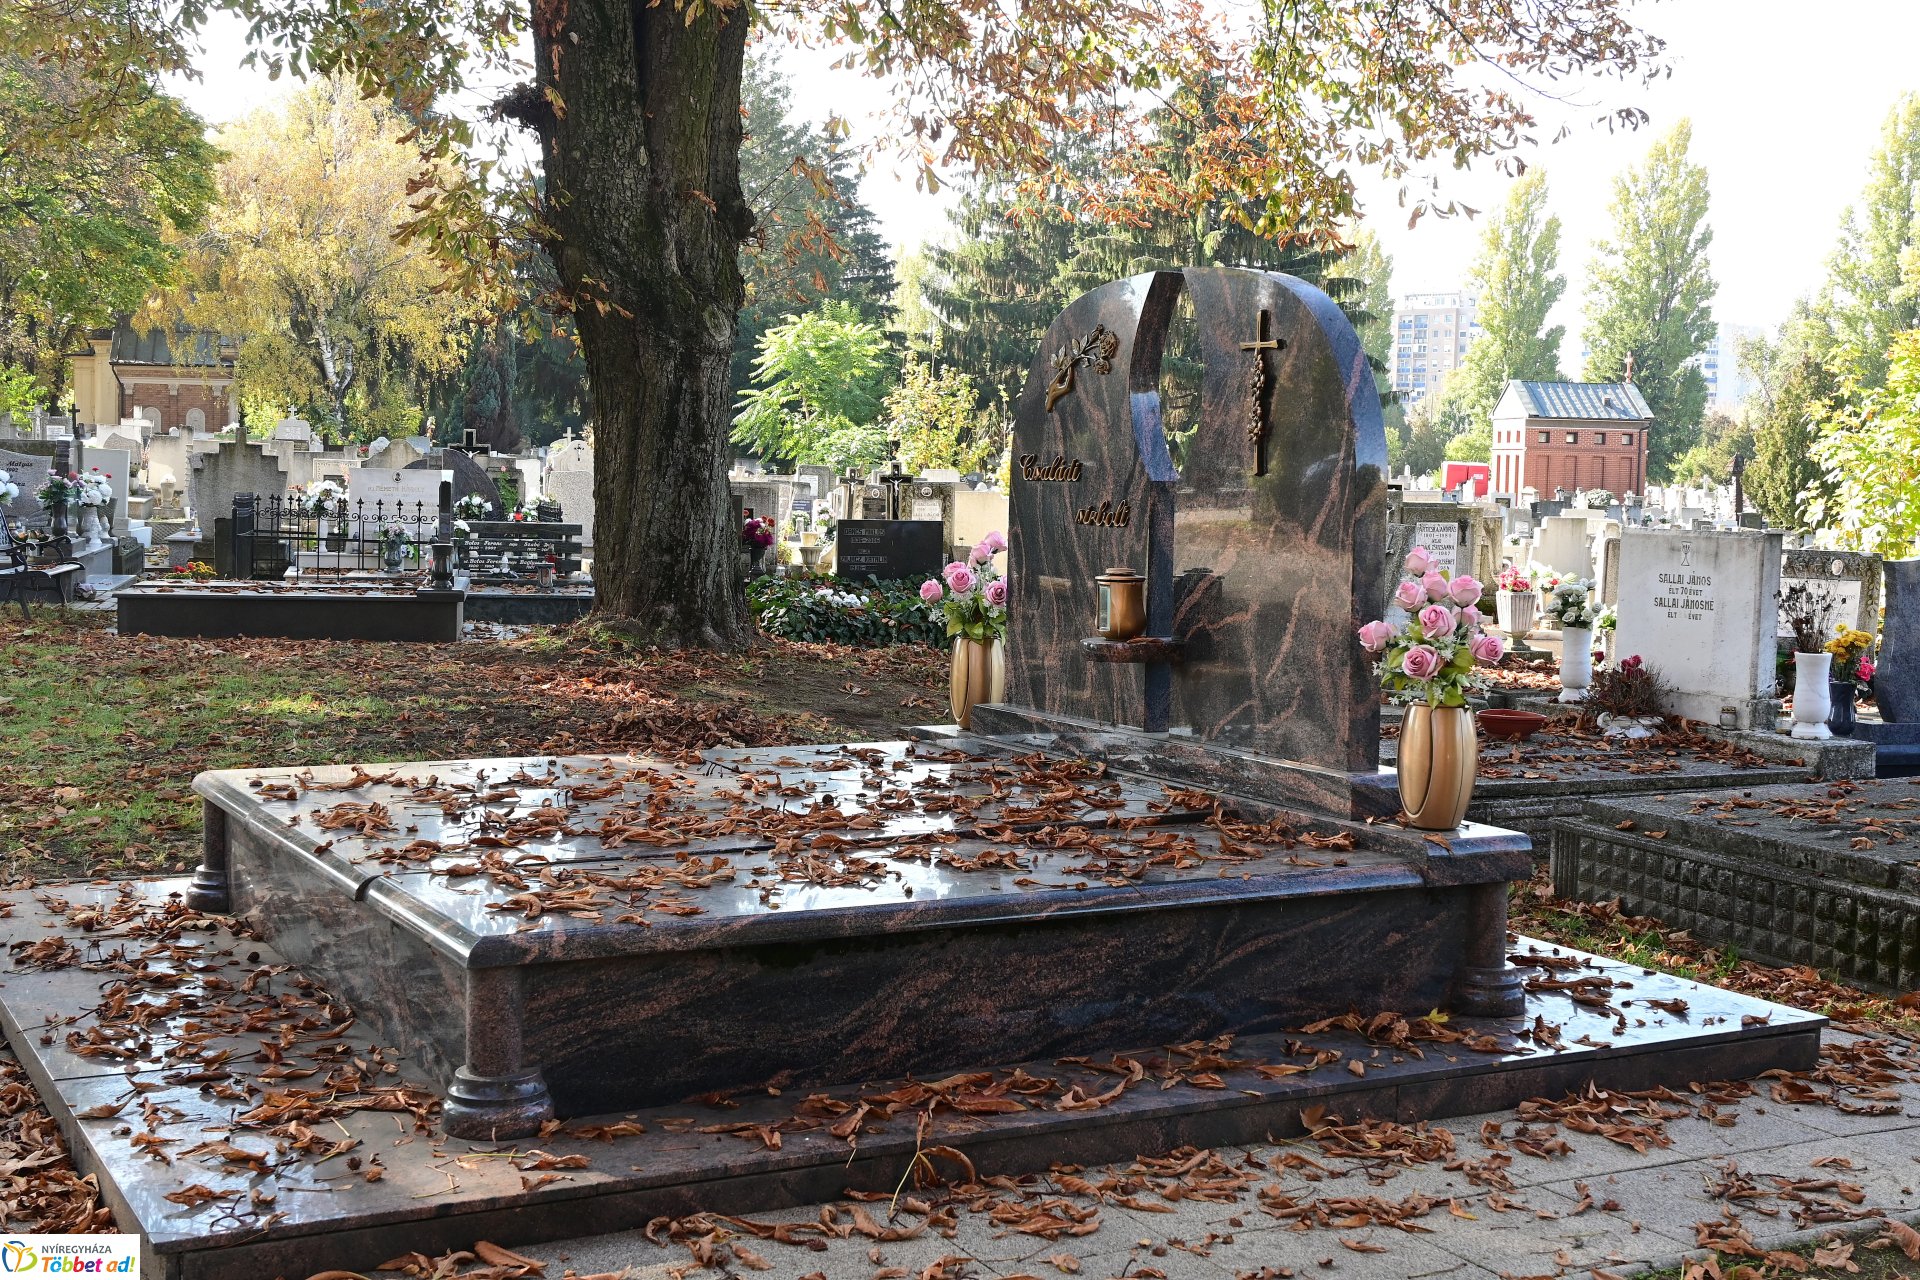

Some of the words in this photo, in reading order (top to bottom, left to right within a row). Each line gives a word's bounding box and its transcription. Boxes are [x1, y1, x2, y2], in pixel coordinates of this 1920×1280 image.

[1019, 453, 1082, 482] Családi
[1658, 573, 1685, 585] SALLAI
[1686, 570, 1712, 587] JÁNOS
[1668, 584, 1679, 595] ÉLT
[1680, 586, 1688, 595] 70
[1688, 586, 1703, 597] ÉVET
[1653, 597, 1679, 609] SALLAI
[1667, 608, 1677, 619] ÉLT
[1688, 610, 1703, 621] ÉVET
